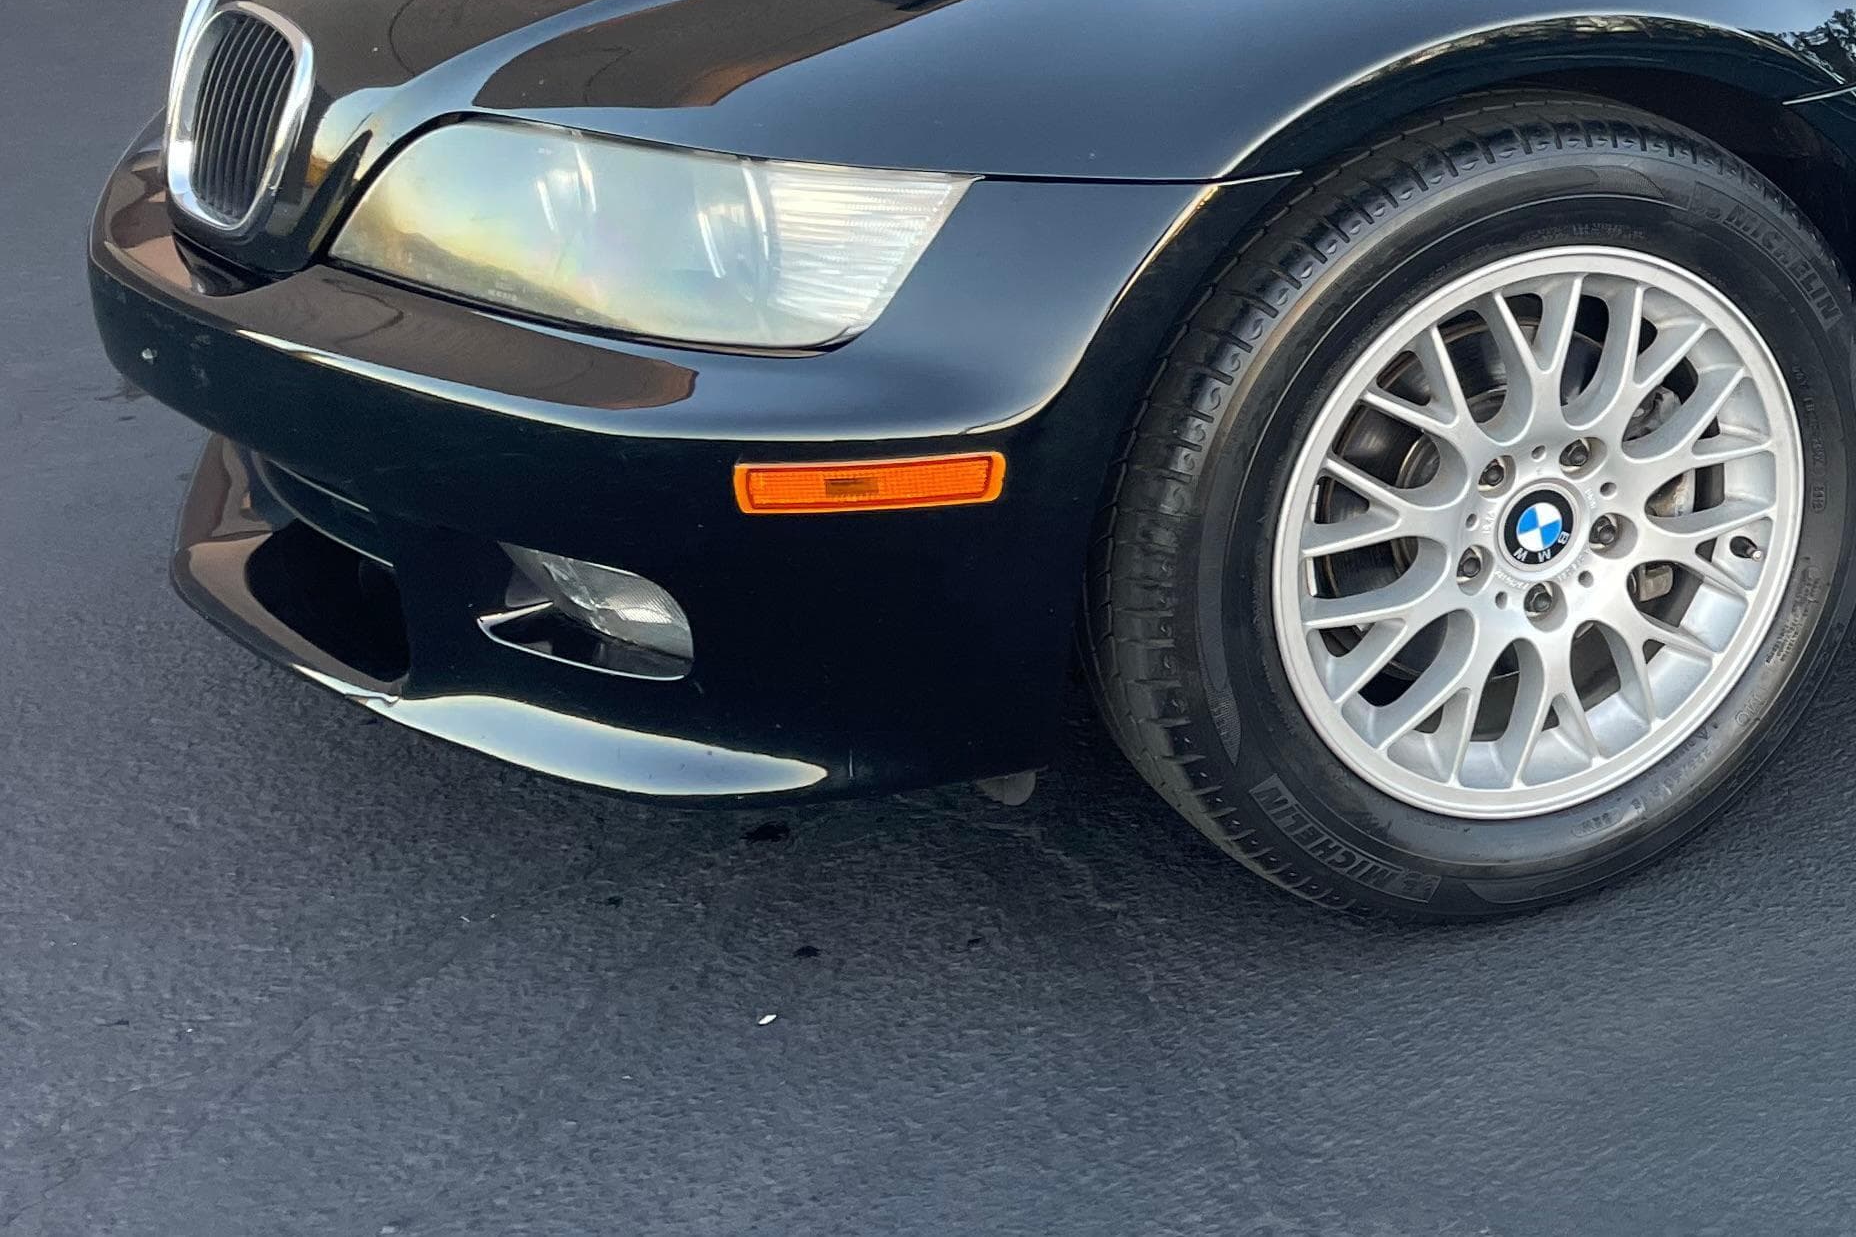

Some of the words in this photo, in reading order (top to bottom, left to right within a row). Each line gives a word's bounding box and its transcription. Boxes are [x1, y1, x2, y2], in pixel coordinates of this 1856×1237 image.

[1724, 204, 1840, 321] MICHELIN
[1513, 530, 1570, 562] BMW
[1257, 786, 1396, 885] MICHELIN
